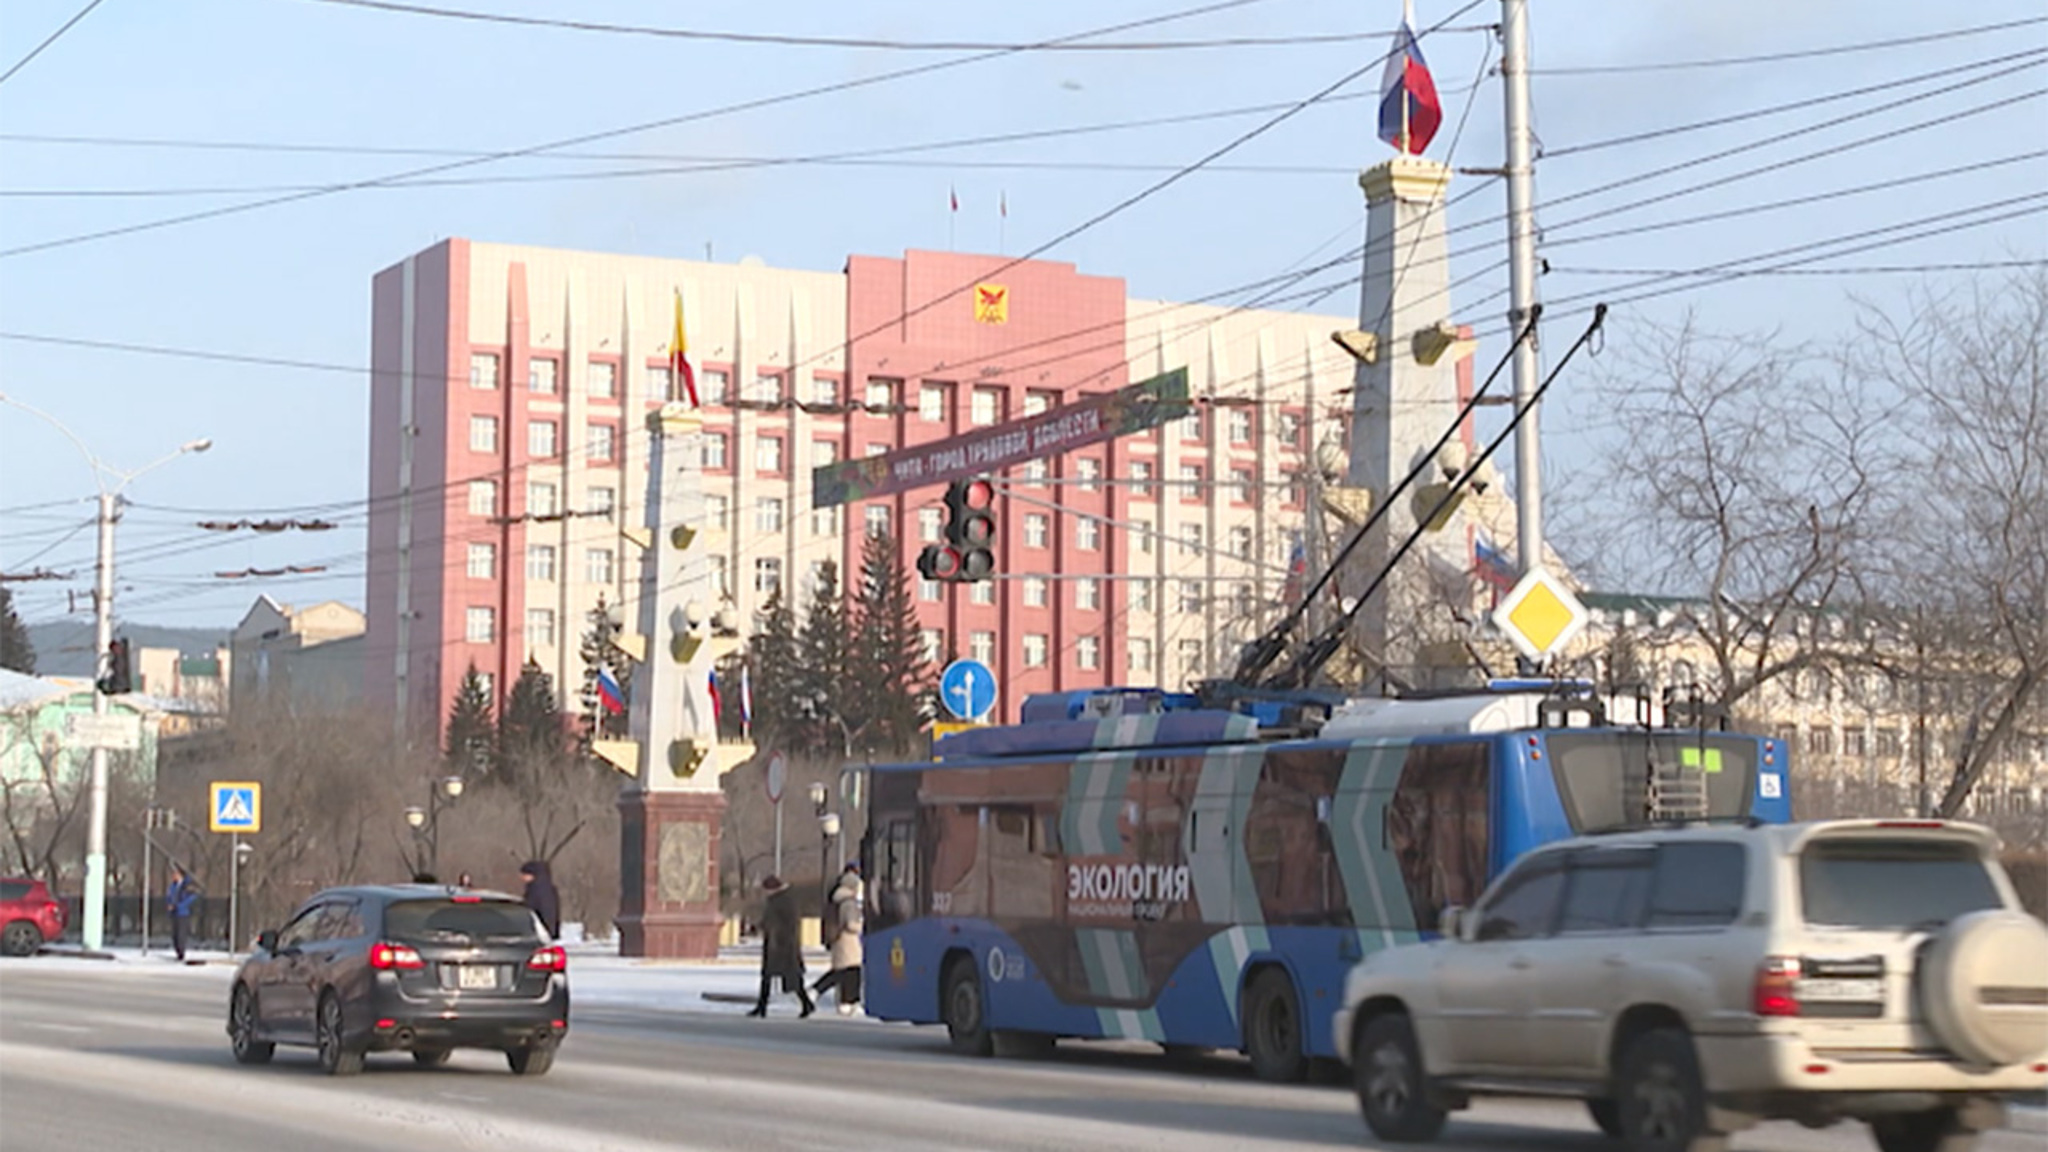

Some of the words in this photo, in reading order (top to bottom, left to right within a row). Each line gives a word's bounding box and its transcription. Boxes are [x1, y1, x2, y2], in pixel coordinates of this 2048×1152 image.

[929, 446, 966, 474] ГОРОД
[968, 427, 1029, 464] ТРУДОВОЙ
[1033, 408, 1100, 449] ДОБЛЕСТИ
[1067, 864, 1189, 900] ЭКОЛОГИЯ
